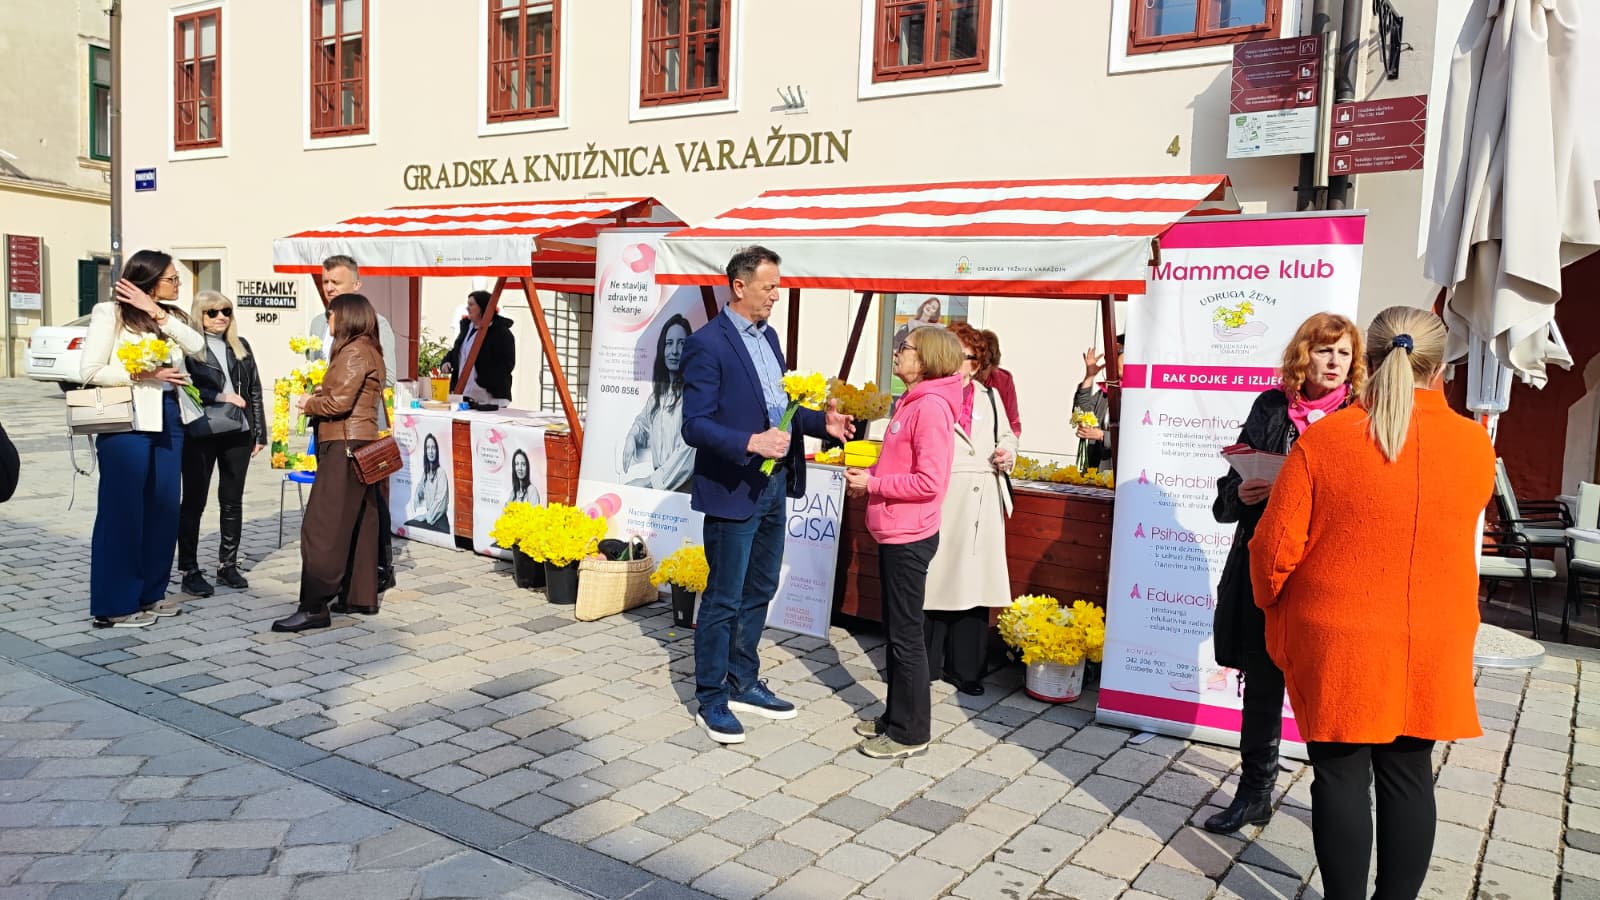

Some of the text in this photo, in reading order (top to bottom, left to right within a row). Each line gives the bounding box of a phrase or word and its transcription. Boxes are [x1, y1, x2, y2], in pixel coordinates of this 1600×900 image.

[1166, 134, 1181, 157] 4
[403, 124, 852, 190] GRADSKA KNJIŽNICA VARAŽDIN
[1152, 258, 1335, 281] Mammae klub
[610, 280, 648, 292] Ne stavljaj
[238, 297, 295, 307] BEST OF CROATIA
[608, 292, 648, 304] zdravlje na
[1199, 290, 1277, 307] UDRUGA ŽENA
[255, 312, 278, 324] SHOP
[612, 305, 642, 316] čekanje
[1162, 373, 1186, 384] RAK
[1189, 374, 1228, 385] DOJKE
[1231, 376, 1244, 386] JE
[600, 384, 620, 394] 0800
[1158, 413, 1241, 430] Preventiva
[1154, 472, 1216, 489] Rehabili
[792, 493, 839, 518] DAN
[788, 515, 836, 542] CISA
[1151, 526, 1235, 548] Psihosocijal
